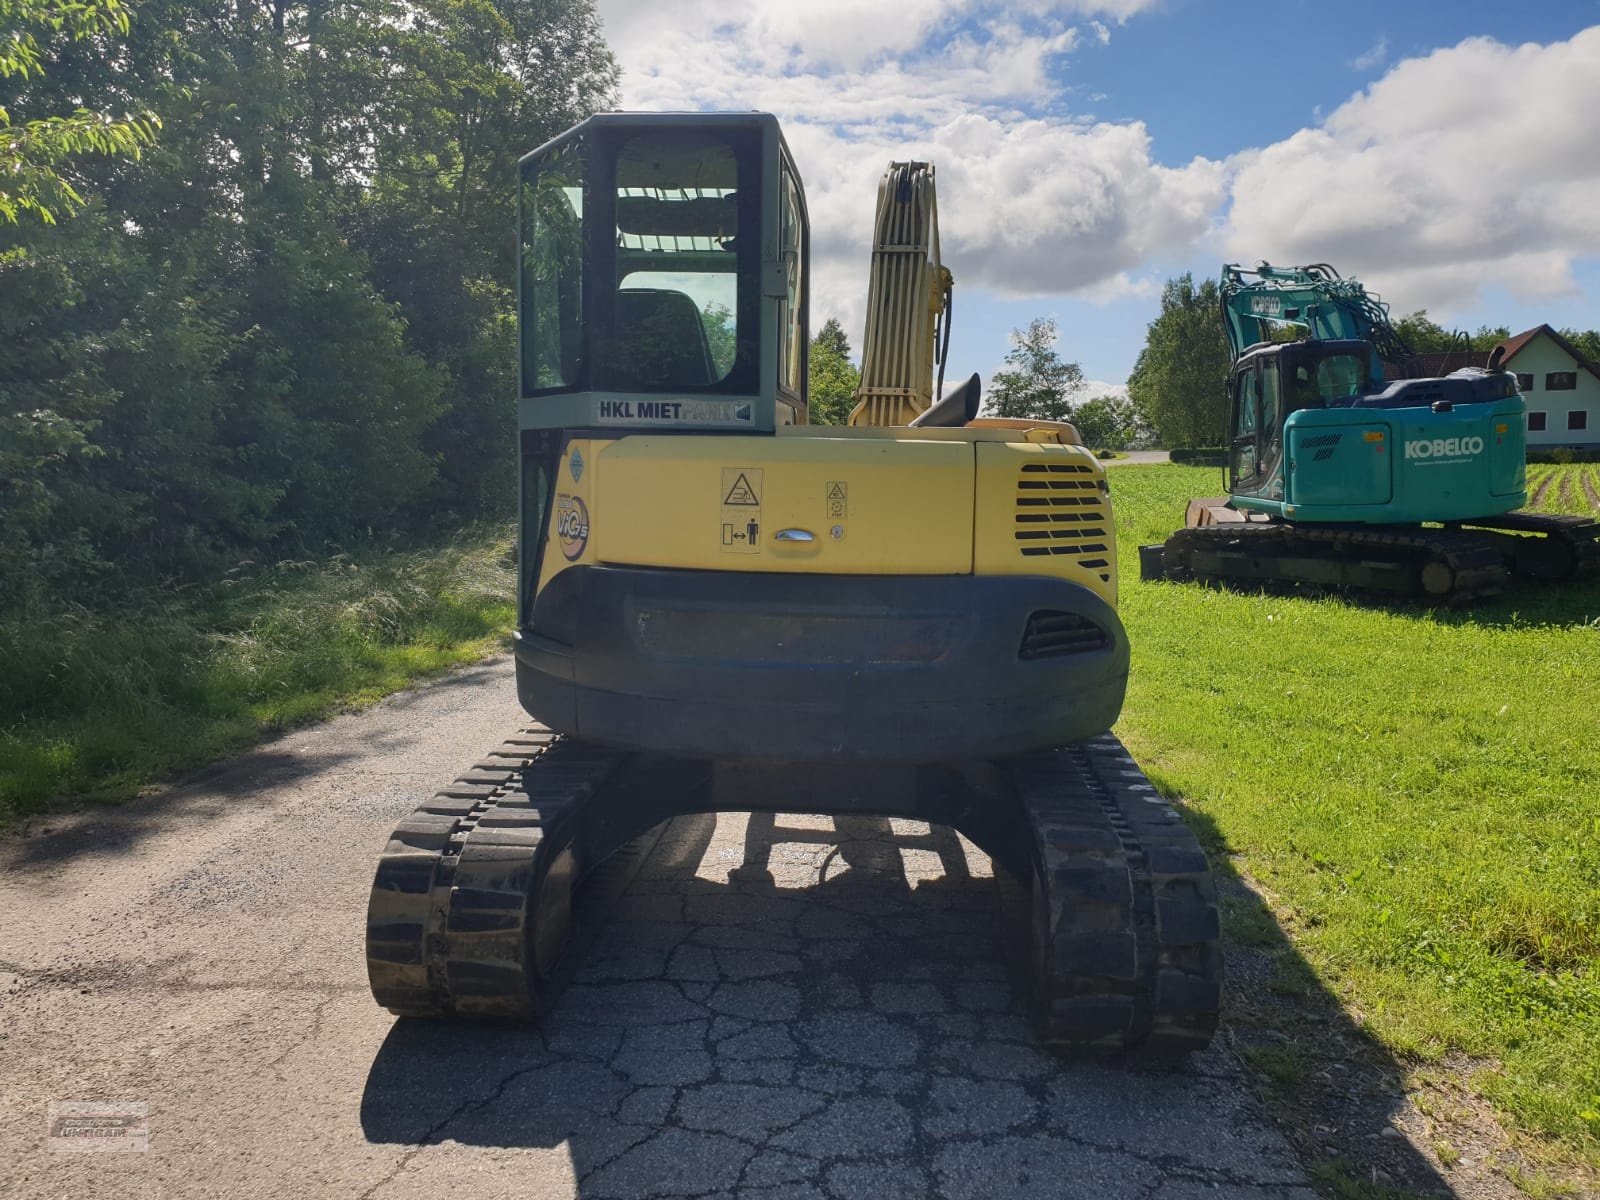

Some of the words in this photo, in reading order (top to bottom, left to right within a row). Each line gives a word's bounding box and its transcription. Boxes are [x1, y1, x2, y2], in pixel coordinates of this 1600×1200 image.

[1251, 295, 1280, 313] KOBELCO
[600, 400, 634, 418] HKL
[1405, 436, 1484, 459] KOBELCO
